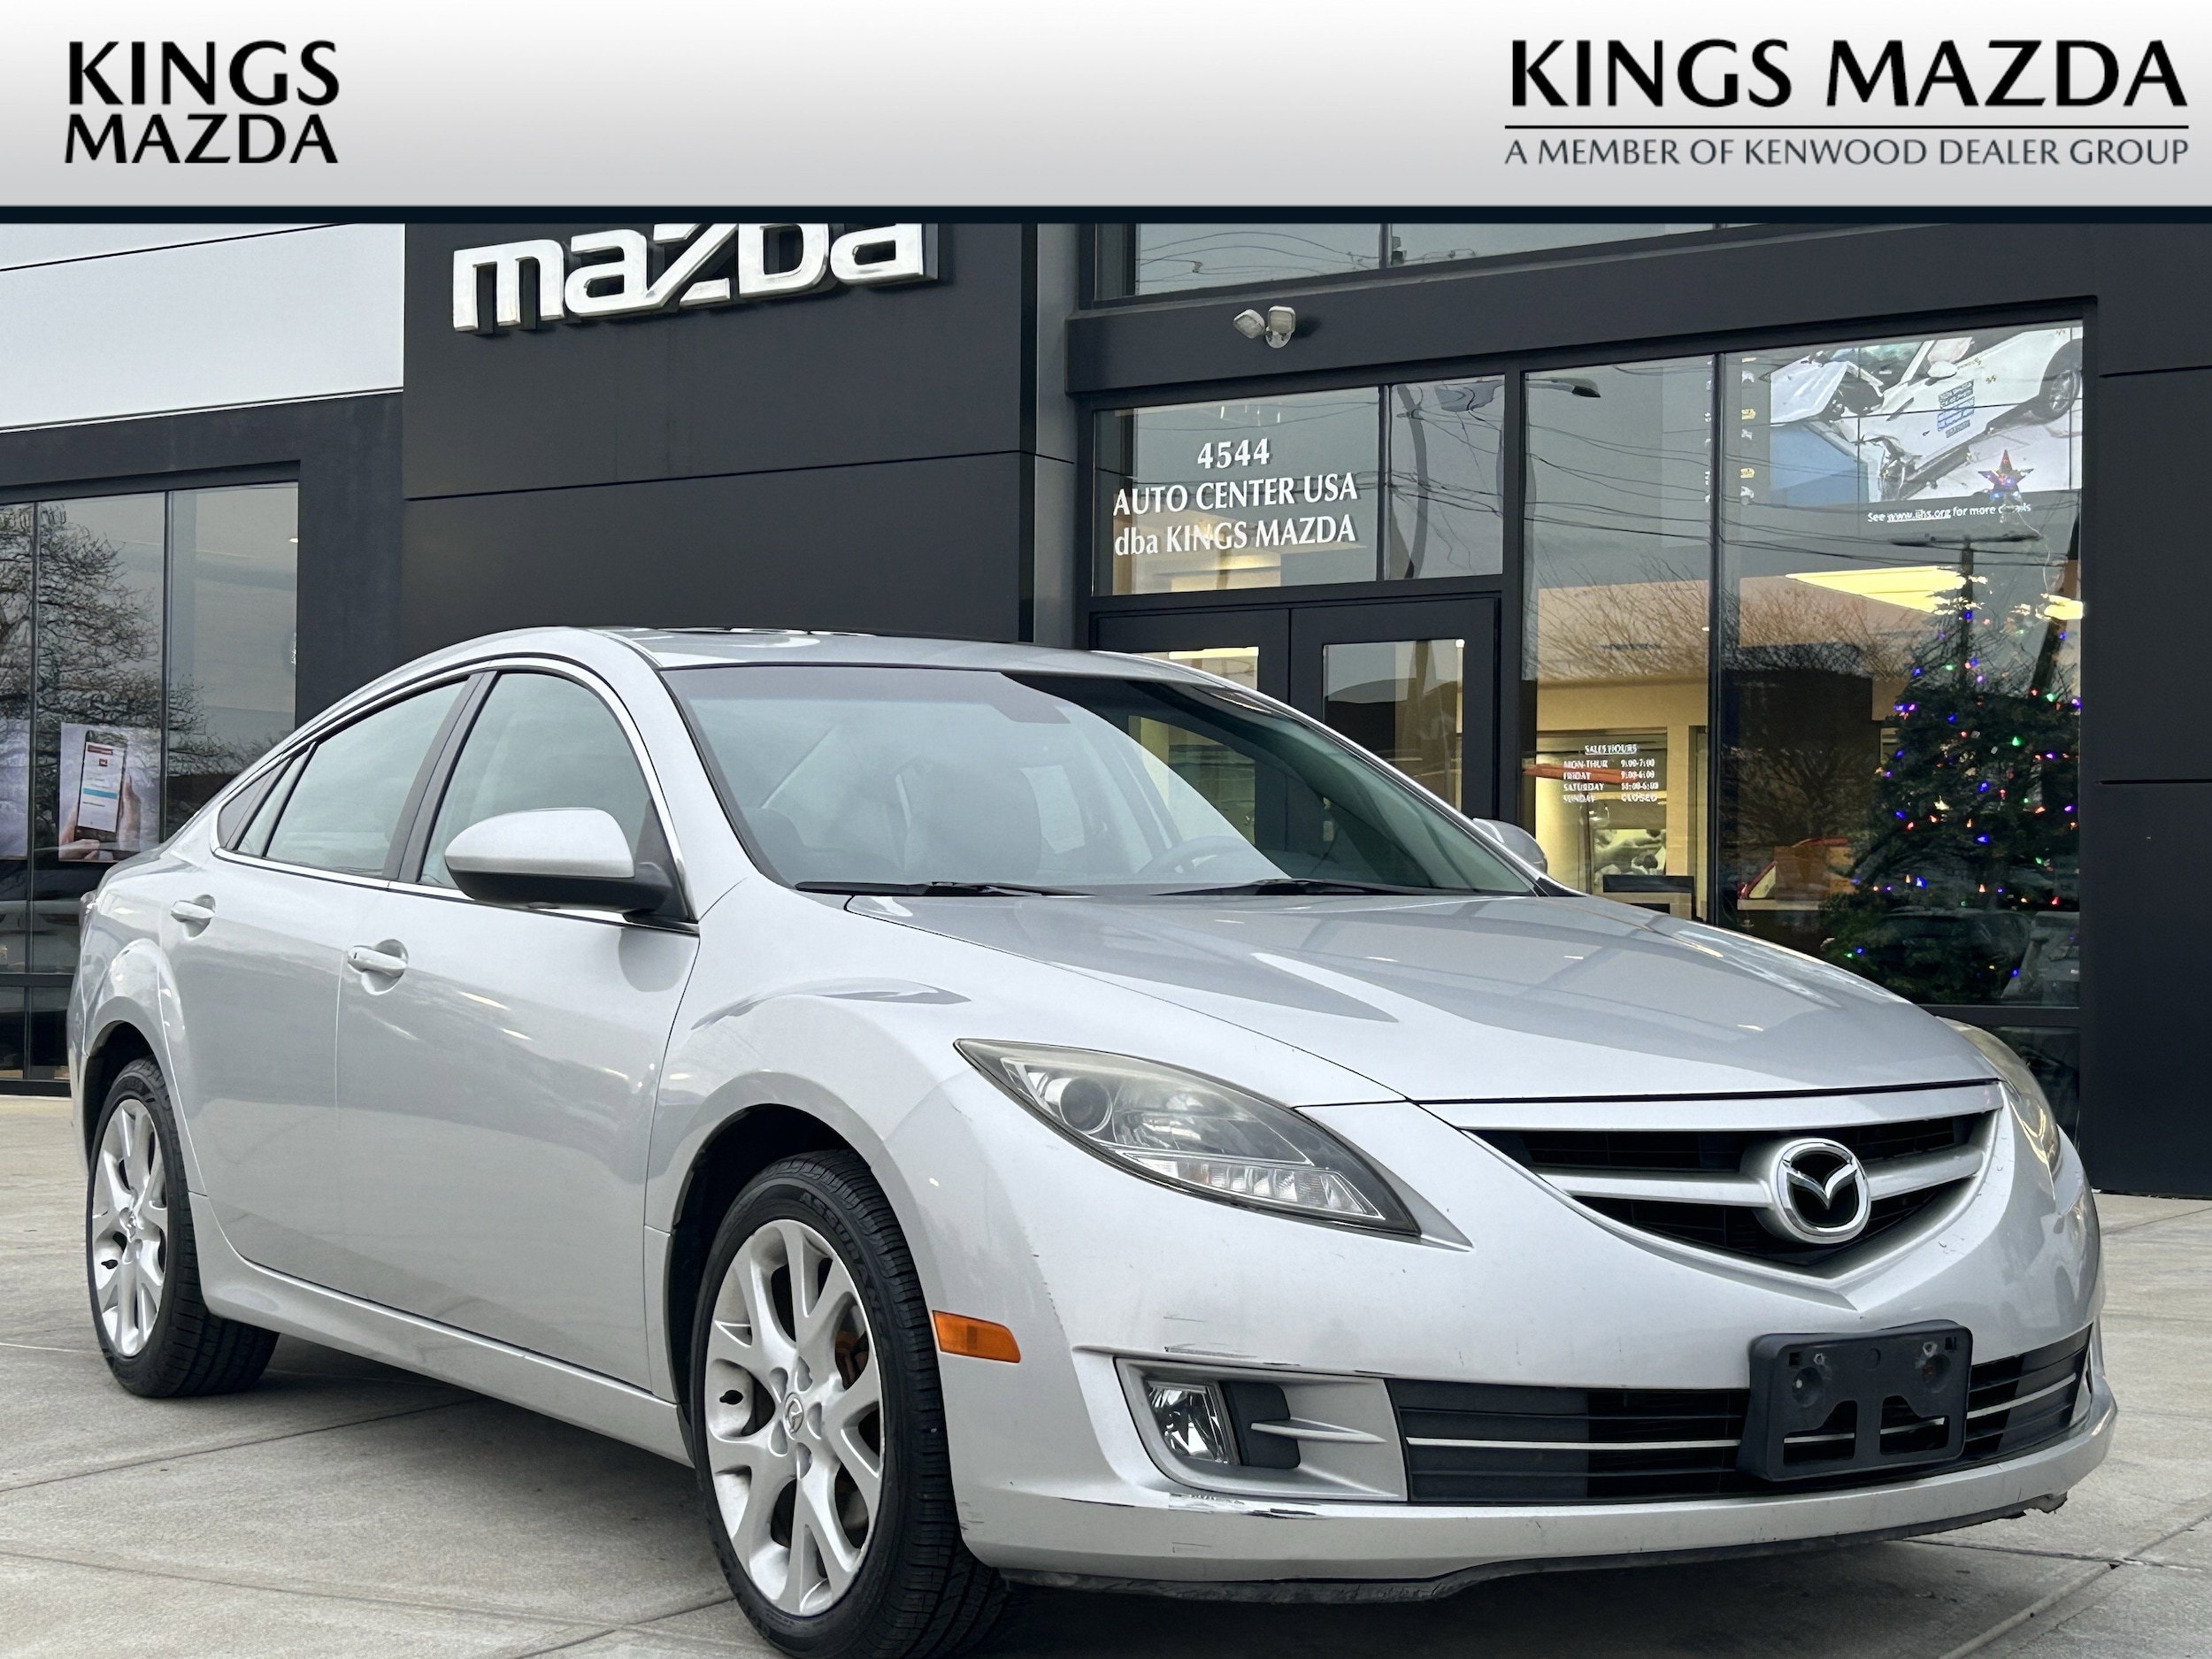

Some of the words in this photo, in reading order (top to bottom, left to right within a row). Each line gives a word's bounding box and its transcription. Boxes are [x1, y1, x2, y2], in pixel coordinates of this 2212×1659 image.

[1197, 438, 1271, 470] 4544
[1112, 484, 1188, 517] AUTO
[1195, 476, 1296, 511] CENTER
[1303, 472, 1358, 504] USA
[1867, 511, 1886, 522] See
[1953, 506, 1968, 517] for
[1970, 506, 1996, 516] more
[1114, 526, 1159, 557] dba
[1166, 520, 1248, 554] KINGS
[1255, 514, 1356, 548] MAZDA
[1563, 772, 1592, 780] FRIDAY
[1563, 782, 1604, 791] SATURDAY
